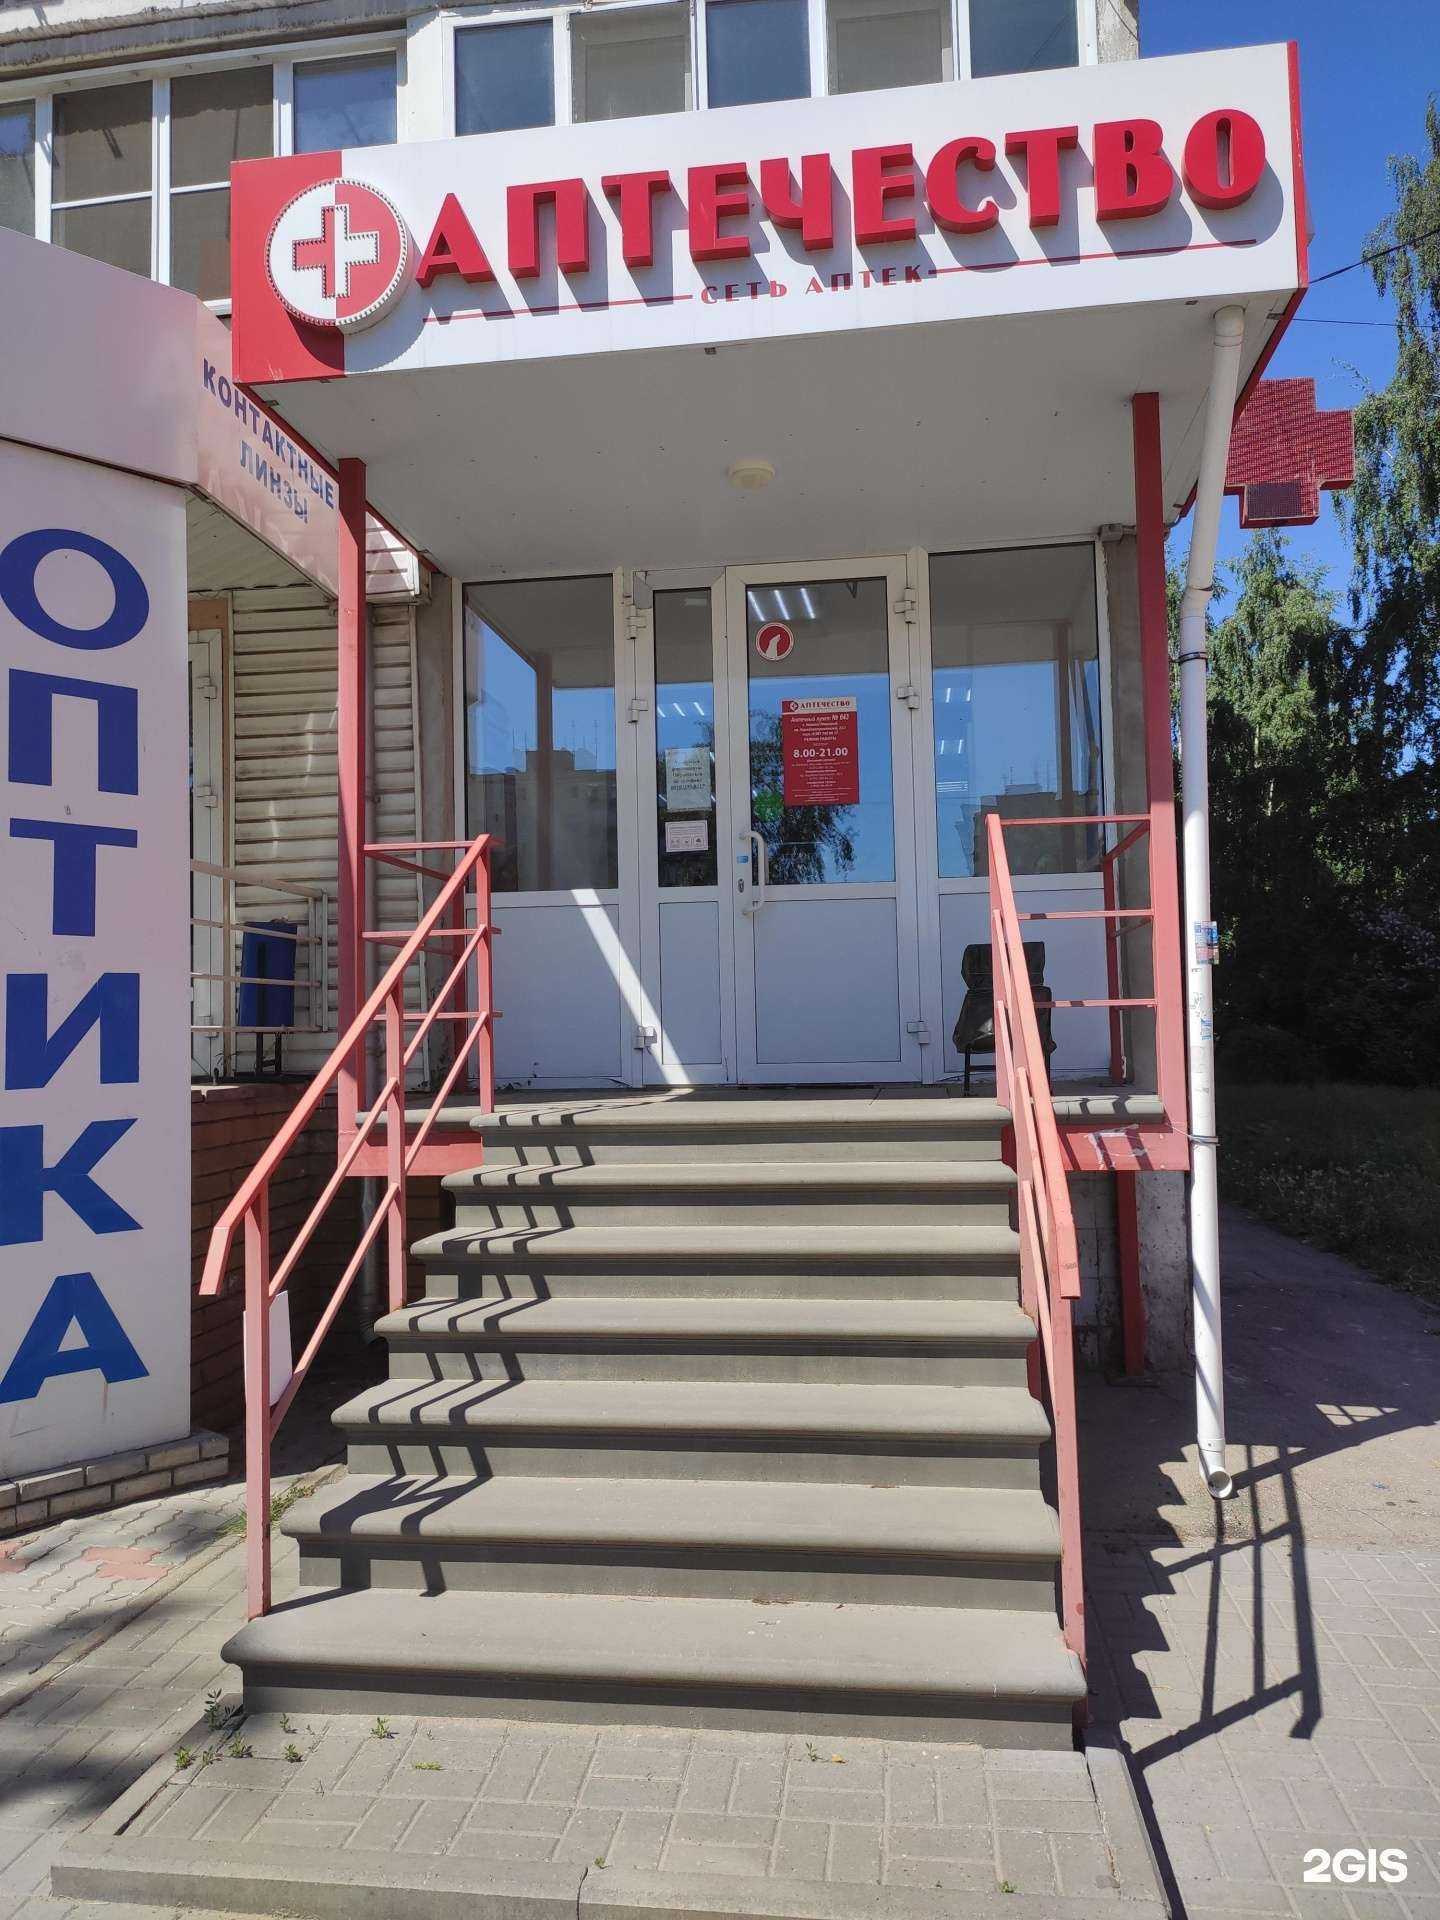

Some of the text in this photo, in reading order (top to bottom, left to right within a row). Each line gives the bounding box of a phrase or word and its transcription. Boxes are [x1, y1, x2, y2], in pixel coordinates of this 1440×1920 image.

[416, 109, 1265, 287] АПТЕЧЕСТВО
[701, 264, 922, 304] СЕТЬ АПТЕК
[203, 358, 334, 509] КОНТАКТНЫЕ
[240, 440, 308, 523] ЛИНЗЫ
[801, 701, 850, 709] АПТЕЧЕСТВО
[793, 747, 849, 758] 8.00-21.00
[0, 528, 150, 1402] ОПТИКА
